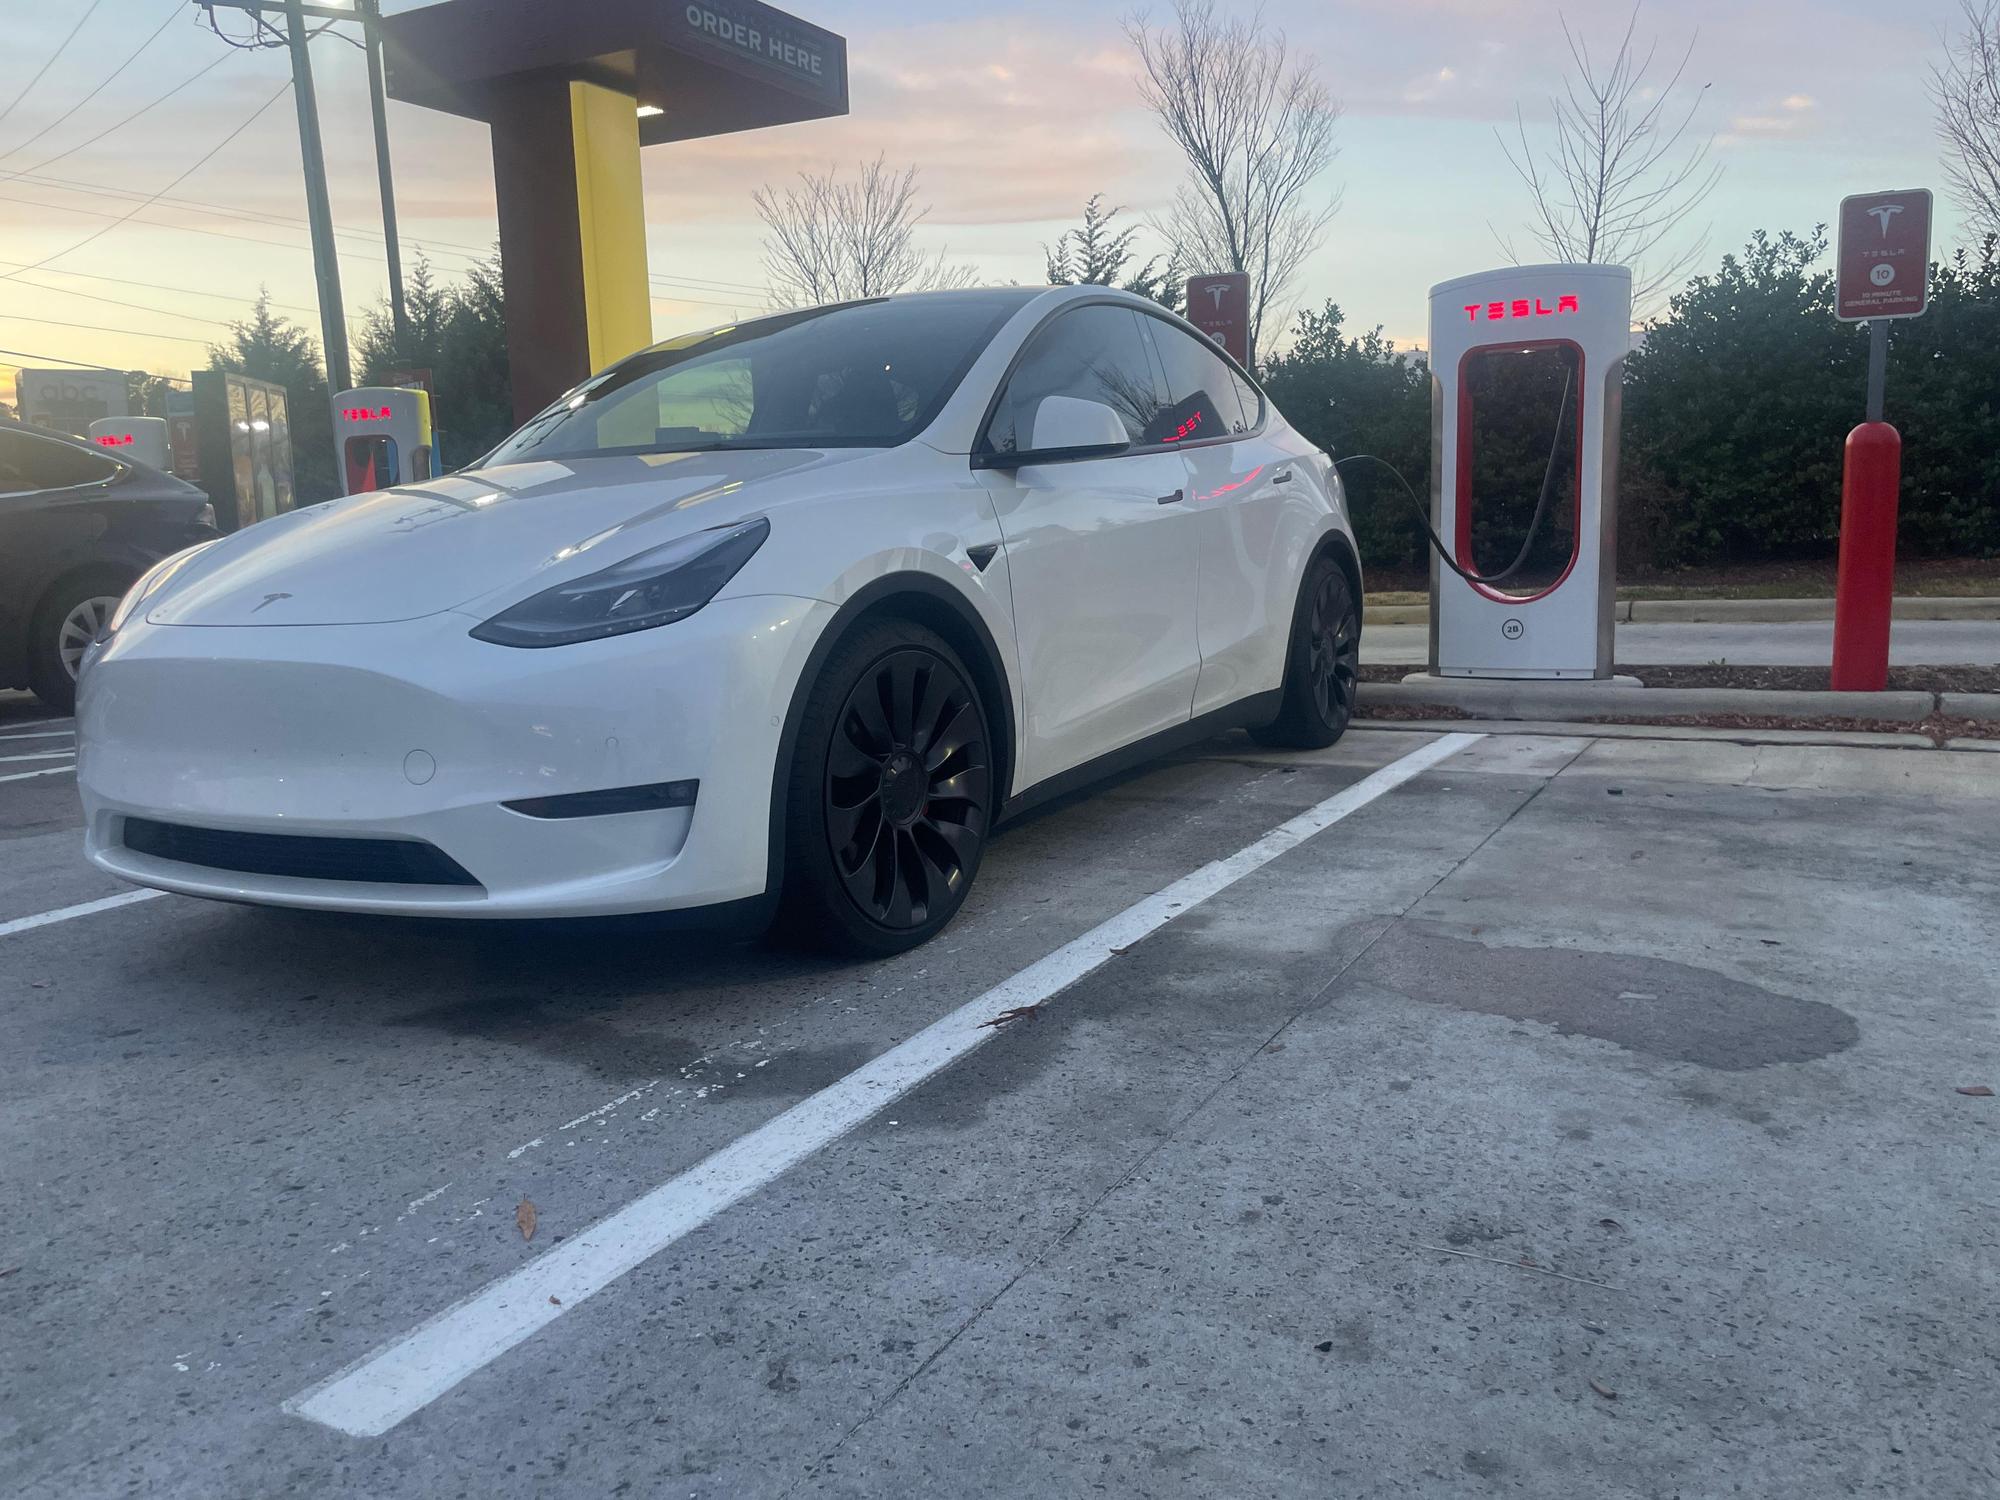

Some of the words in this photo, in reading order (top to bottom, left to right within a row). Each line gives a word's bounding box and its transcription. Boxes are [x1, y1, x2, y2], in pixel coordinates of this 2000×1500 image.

[686, 5, 761, 51] ORDER
[768, 37, 822, 75] HERE
[1862, 248, 1905, 257] TESLA
[1876, 270, 1890, 280] 10
[1464, 295, 1578, 322] TESLA
[40, 378, 98, 400] abc
[343, 407, 392, 421] TESLA
[1507, 625, 1519, 633] 2B
